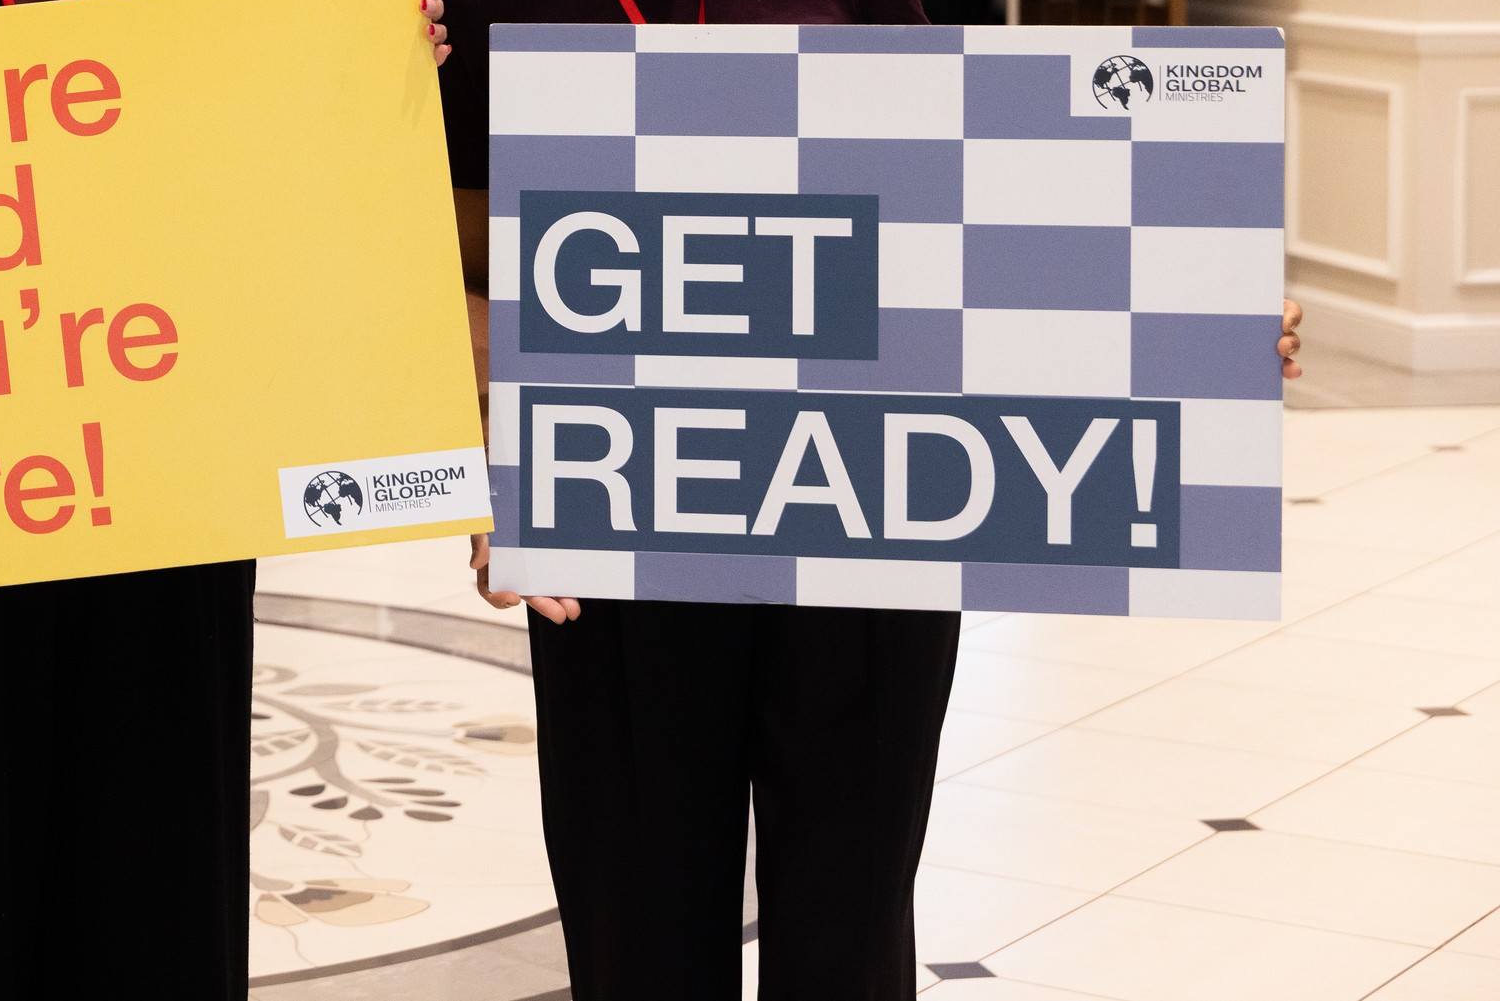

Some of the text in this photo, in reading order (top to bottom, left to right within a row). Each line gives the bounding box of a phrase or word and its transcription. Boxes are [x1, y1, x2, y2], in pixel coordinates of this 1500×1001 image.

[1166, 64, 1263, 79] KINGDOM
[1165, 78, 1246, 93] GLOBAL
[1165, 92, 1224, 102] MINISTRIES
[533, 210, 853, 336] GET
[372, 465, 466, 489] KINGDOM
[531, 403, 1158, 548] READY!
[374, 481, 452, 502] GLOBAL
[375, 497, 432, 513] MINISTRIES
